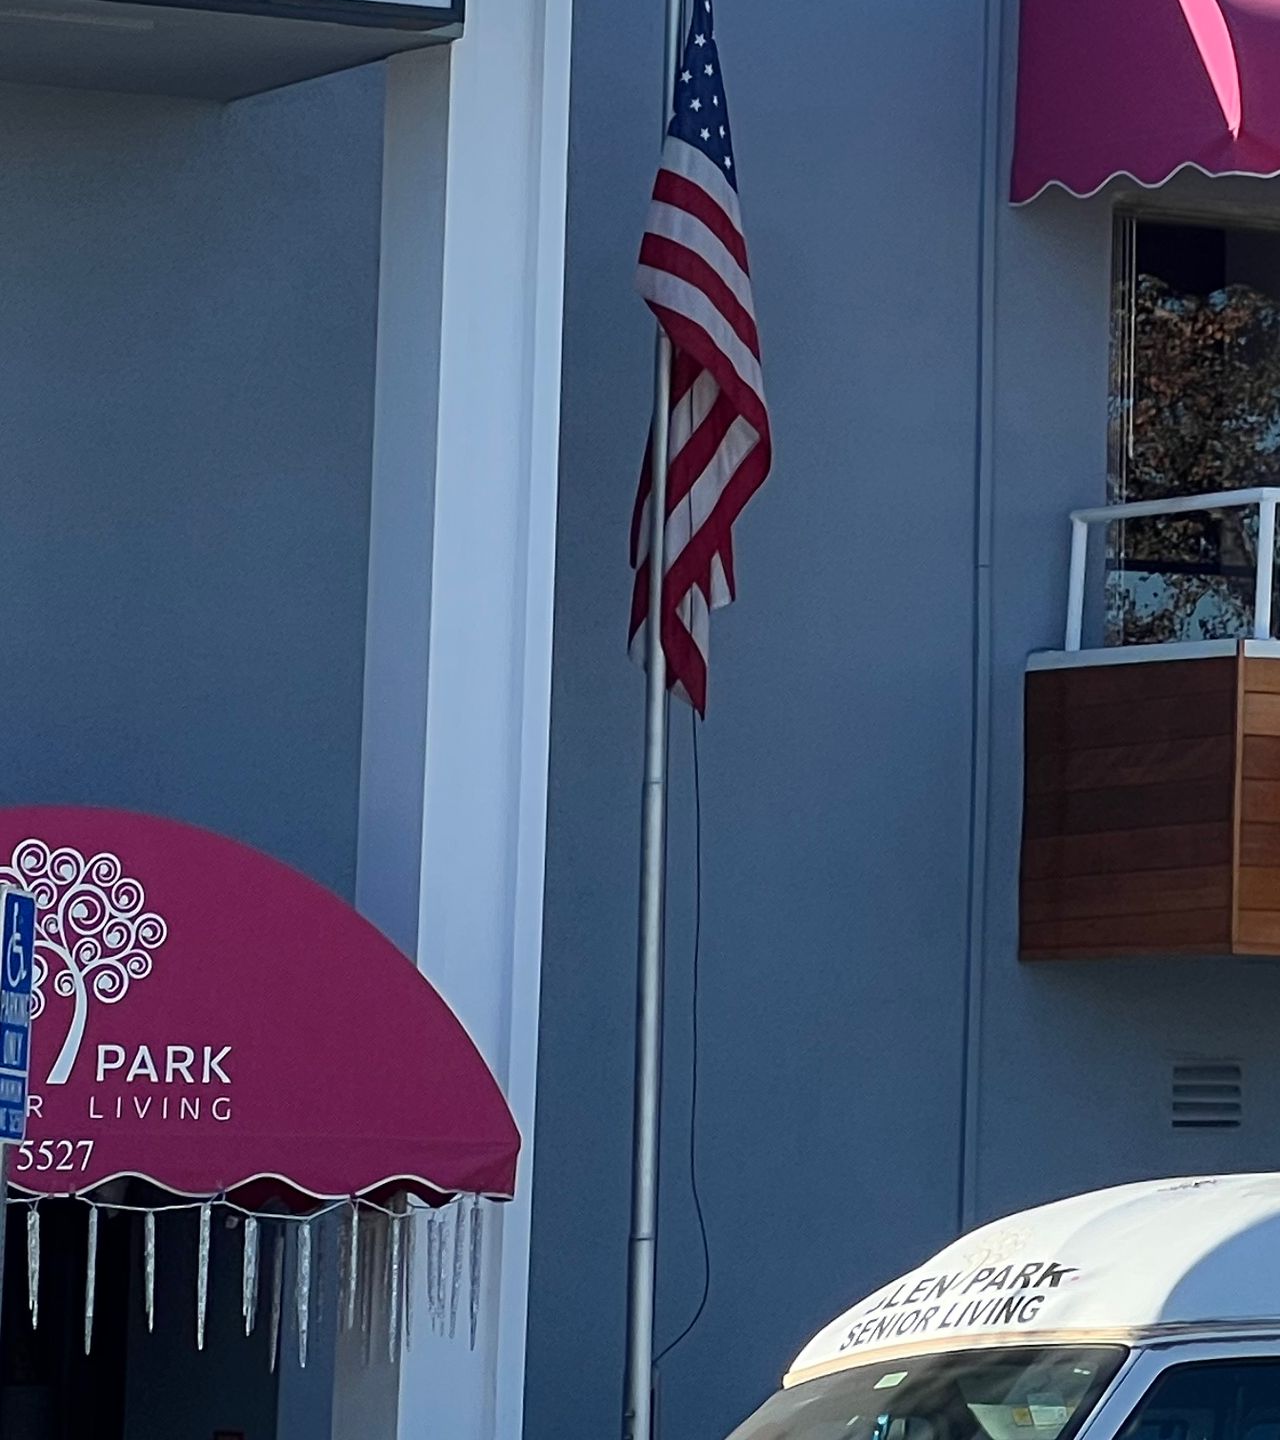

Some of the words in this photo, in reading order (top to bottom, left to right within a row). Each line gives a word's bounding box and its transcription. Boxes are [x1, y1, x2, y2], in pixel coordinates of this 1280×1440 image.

[96, 1045, 233, 1085] PARK
[89, 1095, 233, 1121] LIVING
[16, 1140, 95, 1172] 5527
[864, 1271, 963, 1316] LEN
[961, 1262, 1080, 1296] PARK
[839, 1306, 941, 1352] SENIOR
[937, 1295, 1046, 1329] LIVING
